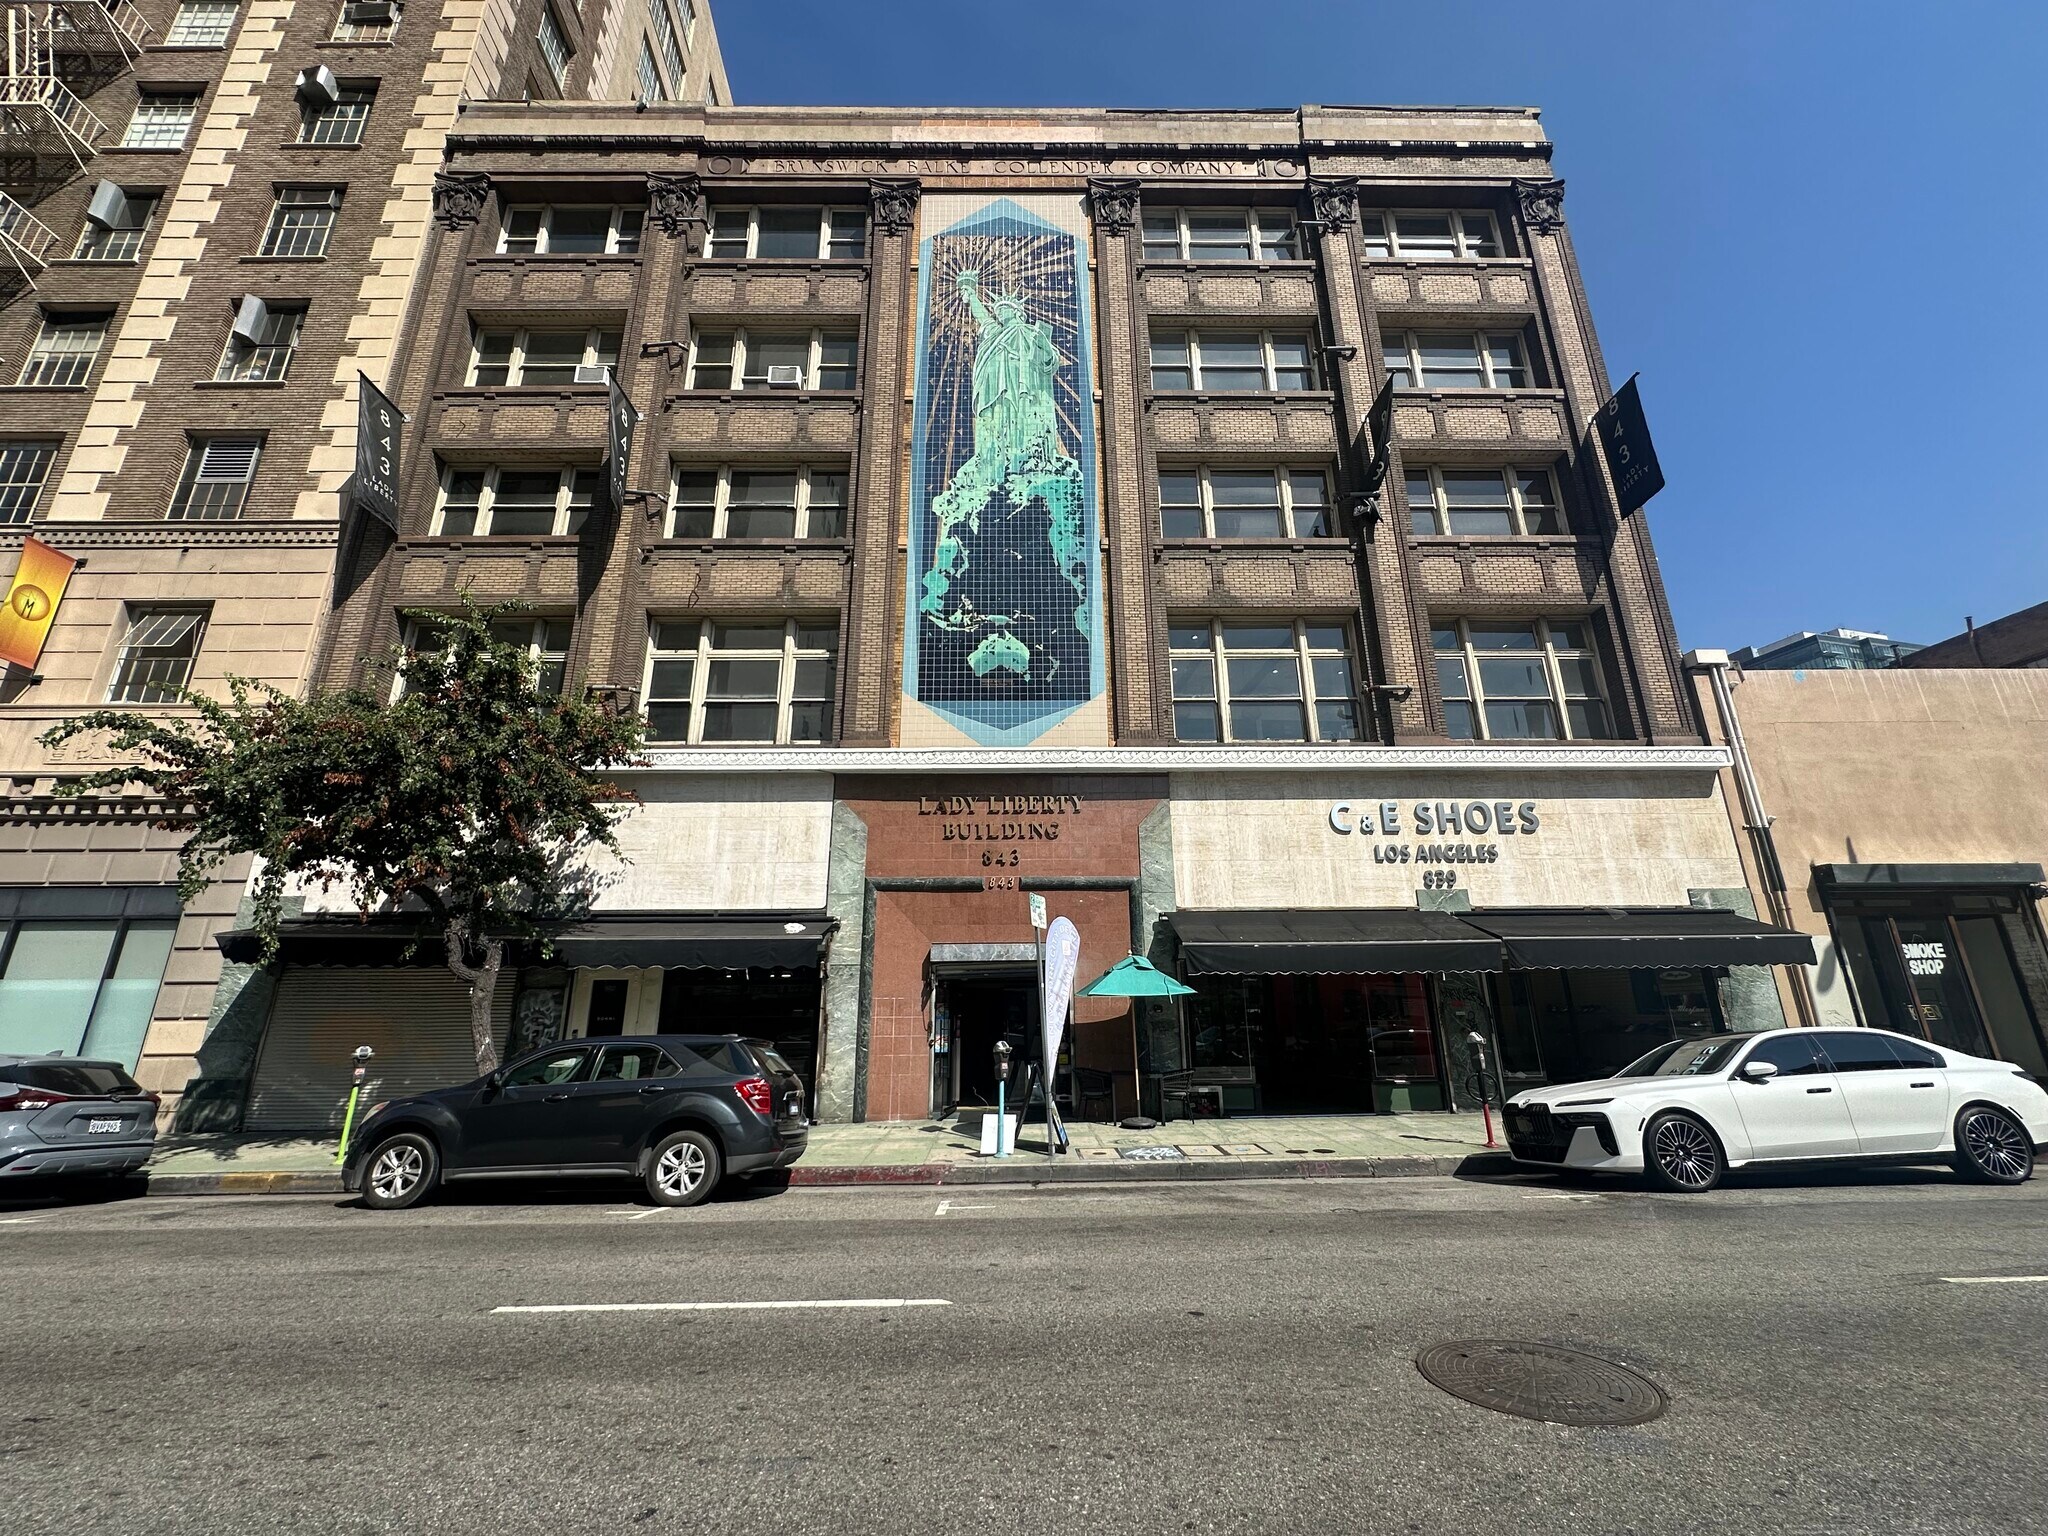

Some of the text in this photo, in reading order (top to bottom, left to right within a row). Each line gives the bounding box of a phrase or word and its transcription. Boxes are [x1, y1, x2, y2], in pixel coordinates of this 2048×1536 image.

[906, 160, 970, 173] BALKE
[994, 161, 1114, 174] COLLENDER
[1136, 161, 1236, 174] COMPANY
[380, 408, 391, 477] 843
[363, 477, 398, 507] LIBERTY
[372, 474, 394, 495] LADY
[918, 795, 1084, 815] LADY LIBERTY
[1413, 801, 1540, 835] SHOES
[942, 821, 1060, 841] BUILDING
[982, 849, 1020, 867] 843
[1373, 844, 1499, 864] LOS ANGELES
[988, 877, 1015, 890] 843
[1423, 870, 1457, 889] 839
[1902, 943, 1946, 958] SMOKE
[1909, 960, 1944, 975] SHOP
